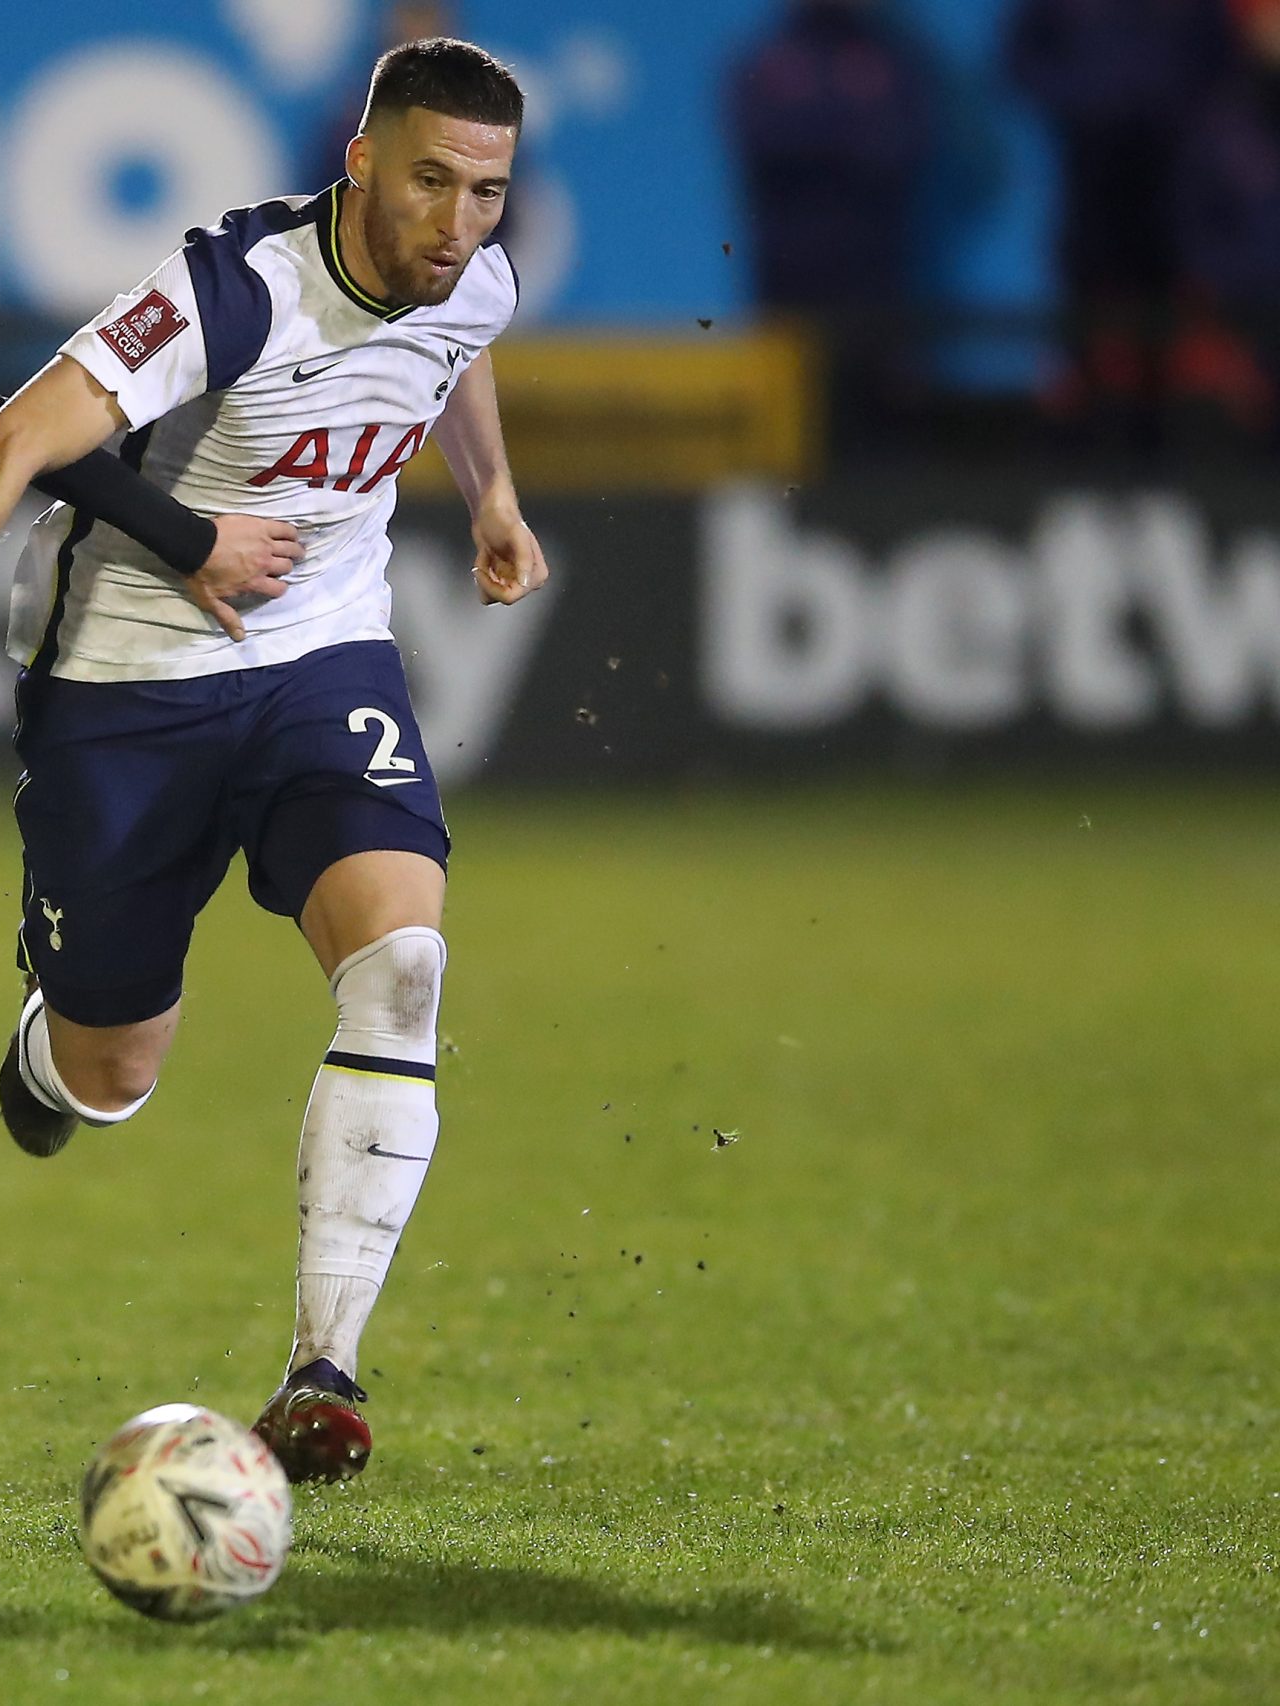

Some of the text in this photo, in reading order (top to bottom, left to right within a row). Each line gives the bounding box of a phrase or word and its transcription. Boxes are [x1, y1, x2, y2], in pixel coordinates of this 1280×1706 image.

[105, 323, 141, 359] FA CUP
[246, 421, 427, 494] AIA
[347, 706, 416, 773] 2
